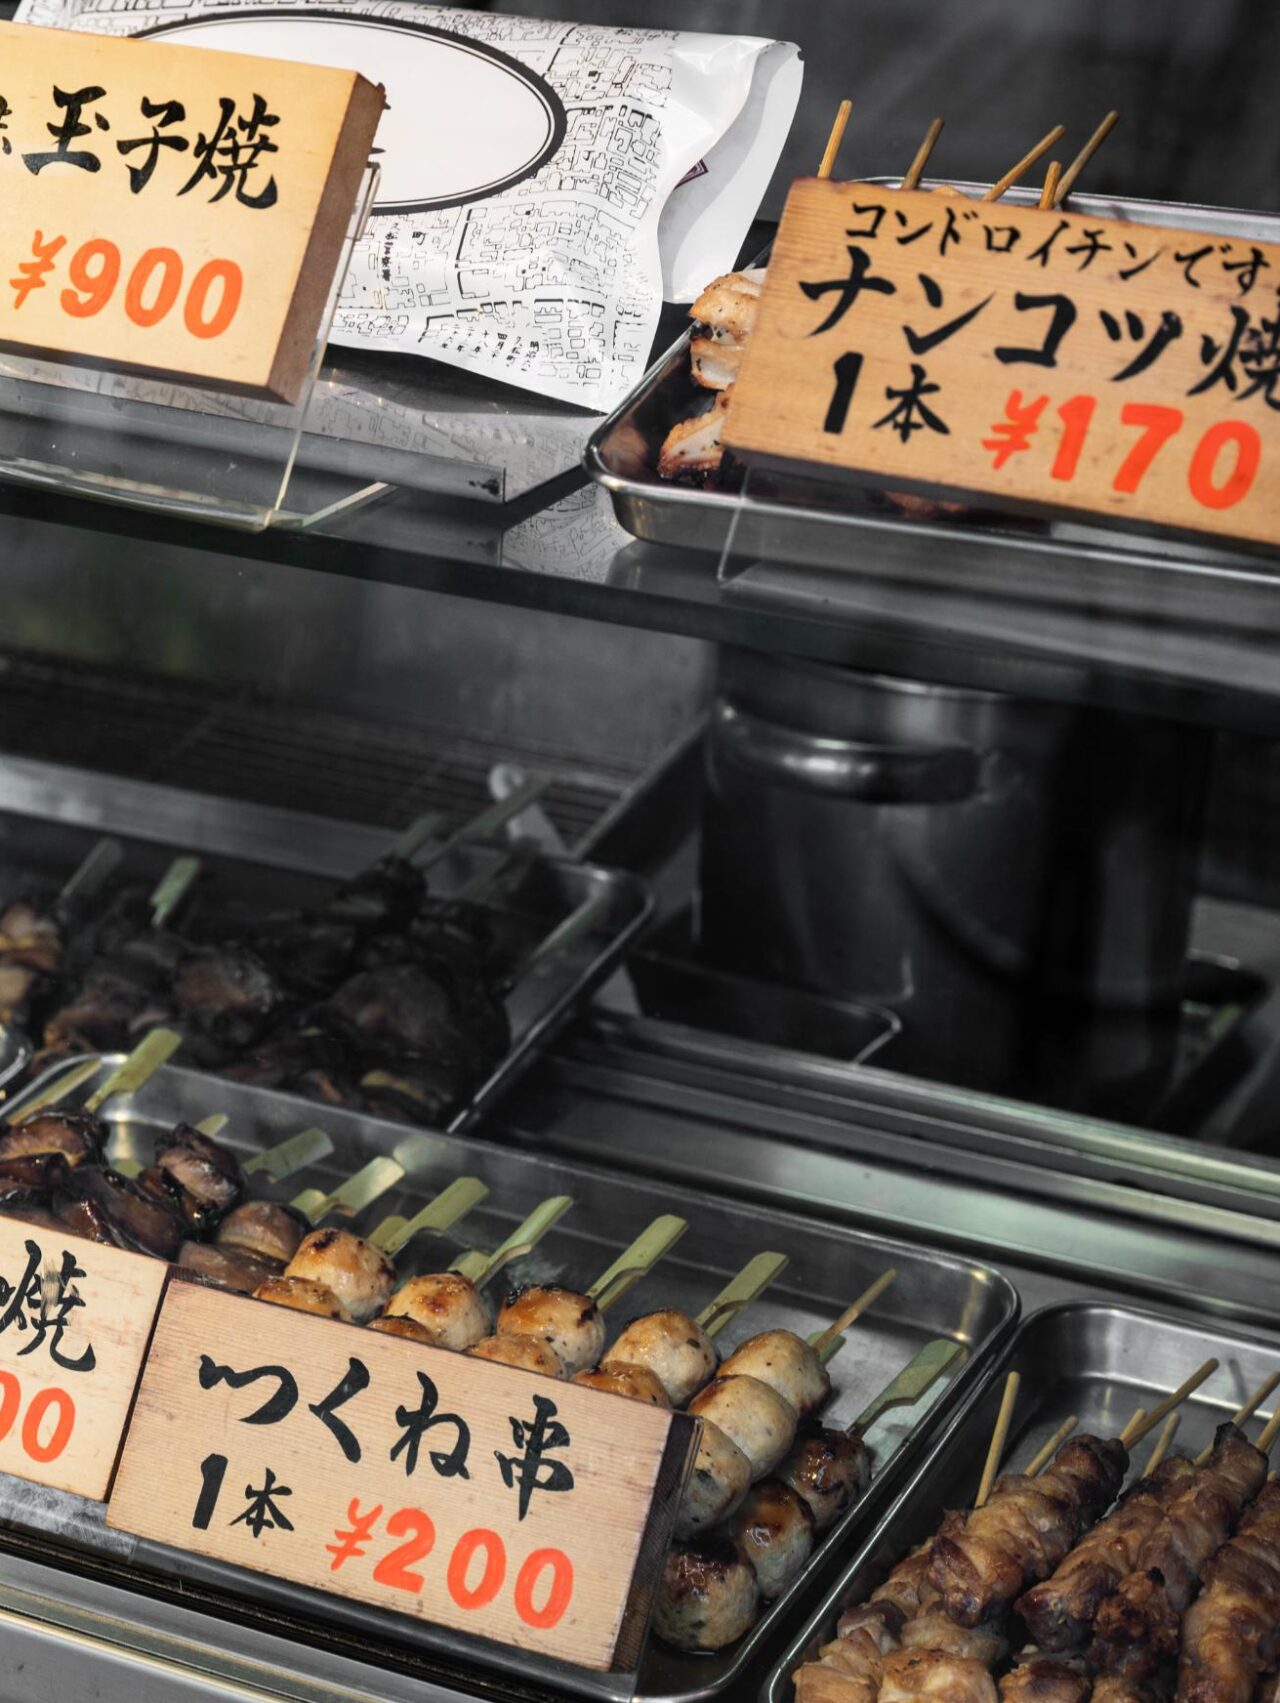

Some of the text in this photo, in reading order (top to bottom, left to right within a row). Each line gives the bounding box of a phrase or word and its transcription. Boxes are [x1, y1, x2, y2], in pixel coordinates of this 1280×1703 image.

[20, 83, 281, 209] 玉子焼
[9, 229, 243, 340] ¥900
[845, 201, 1271, 297] コンドロイチンです
[823, 351, 1263, 511] 1本 ¥170
[198, 1353, 575, 1522] つくね串
[191, 1453, 575, 1631] 1本 ¥200
